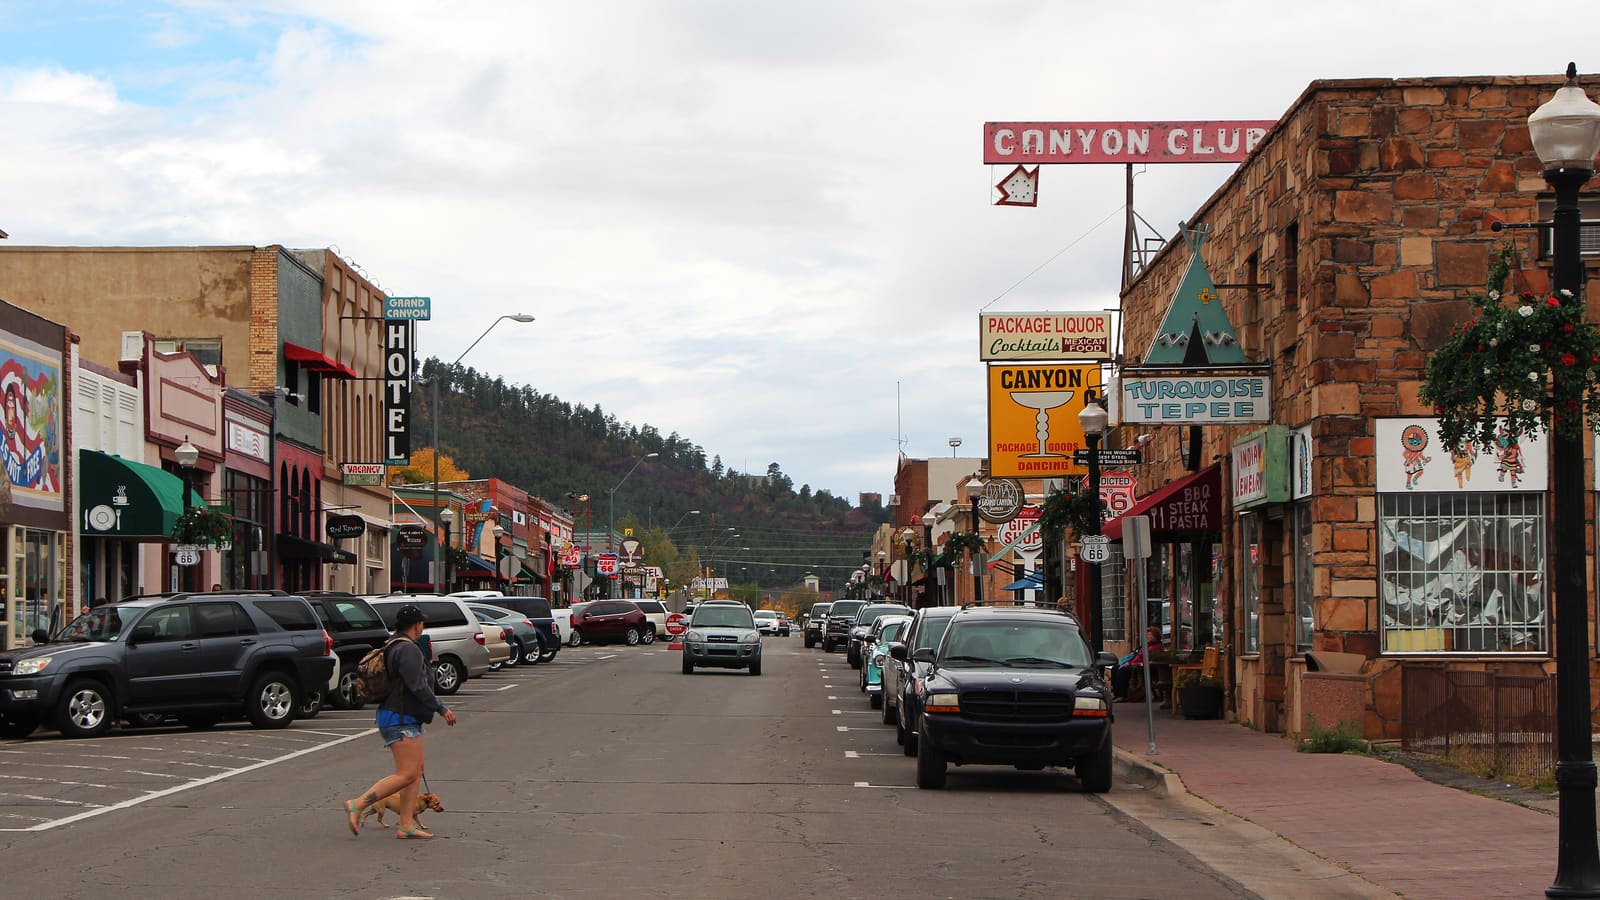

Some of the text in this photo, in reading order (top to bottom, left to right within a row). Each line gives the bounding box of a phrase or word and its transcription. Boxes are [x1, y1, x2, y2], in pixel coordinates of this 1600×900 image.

[994, 128, 1149, 156] CANYON
[390, 298, 425, 307] GRAND
[387, 309, 428, 318] CANYON
[988, 317, 1105, 334] PACKAGE LIQUOR
[990, 337, 1060, 355] Cocktails
[1064, 337, 1107, 346] MEXICAN
[1069, 345, 1102, 353] FOOD
[1001, 369, 1082, 389] CANYON
[388, 325, 407, 459] HOTEL
[1124, 378, 1264, 400] TURQUOISE
[1137, 402, 1255, 419] TEPEE
[997, 442, 1080, 453] PACKAGE GOODS
[8, 455, 21, 484] NOT
[347, 465, 382, 474] VACANCY
[1018, 461, 1069, 471] DANCING
[1100, 477, 1130, 485] DICTED
[1184, 484, 1210, 502] BBQ
[1169, 499, 1209, 515] STEAK
[1169, 514, 1209, 530] PASTA
[1004, 531, 1040, 544] SHOP
[181, 555, 192, 563] 66
[1089, 549, 1103, 560] 66
